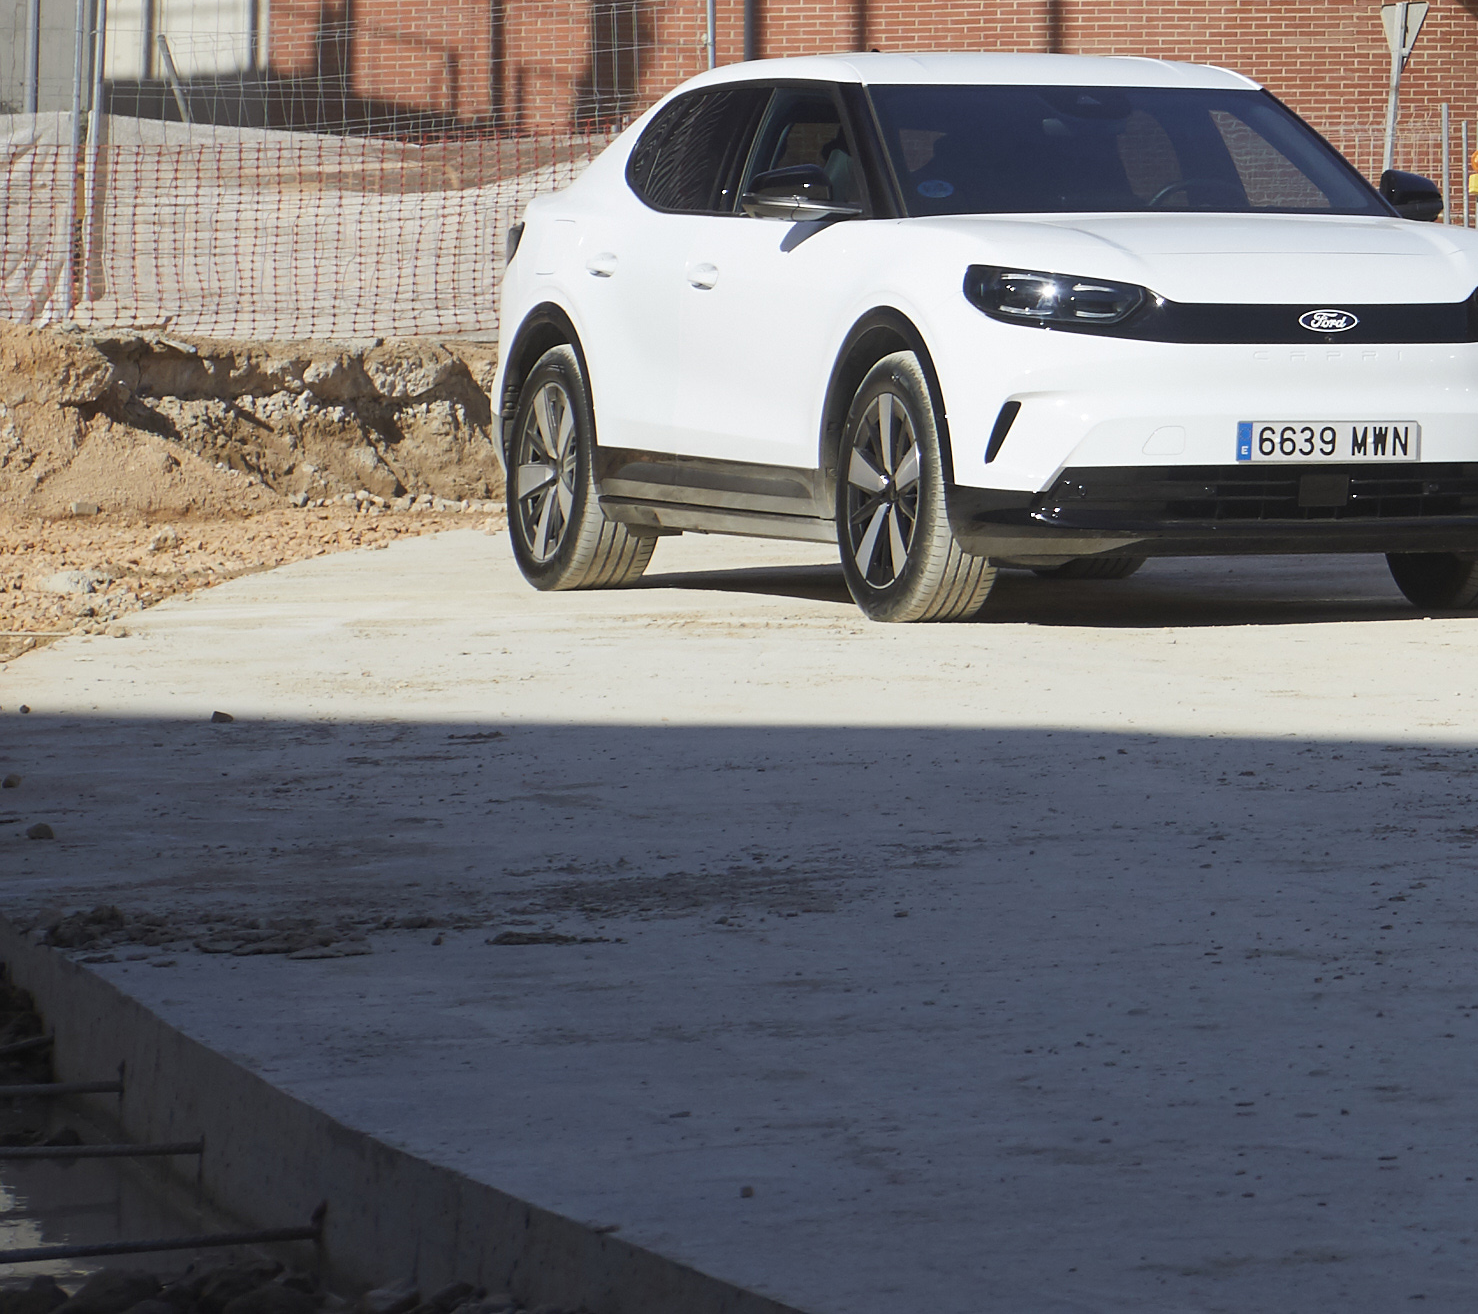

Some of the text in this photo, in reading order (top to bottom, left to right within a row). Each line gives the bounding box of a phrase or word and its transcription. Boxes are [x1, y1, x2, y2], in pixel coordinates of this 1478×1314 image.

[1308, 311, 1349, 329] Ford
[1253, 350, 1402, 361] CAPRI
[1241, 426, 1409, 456] E 6639 MWN
